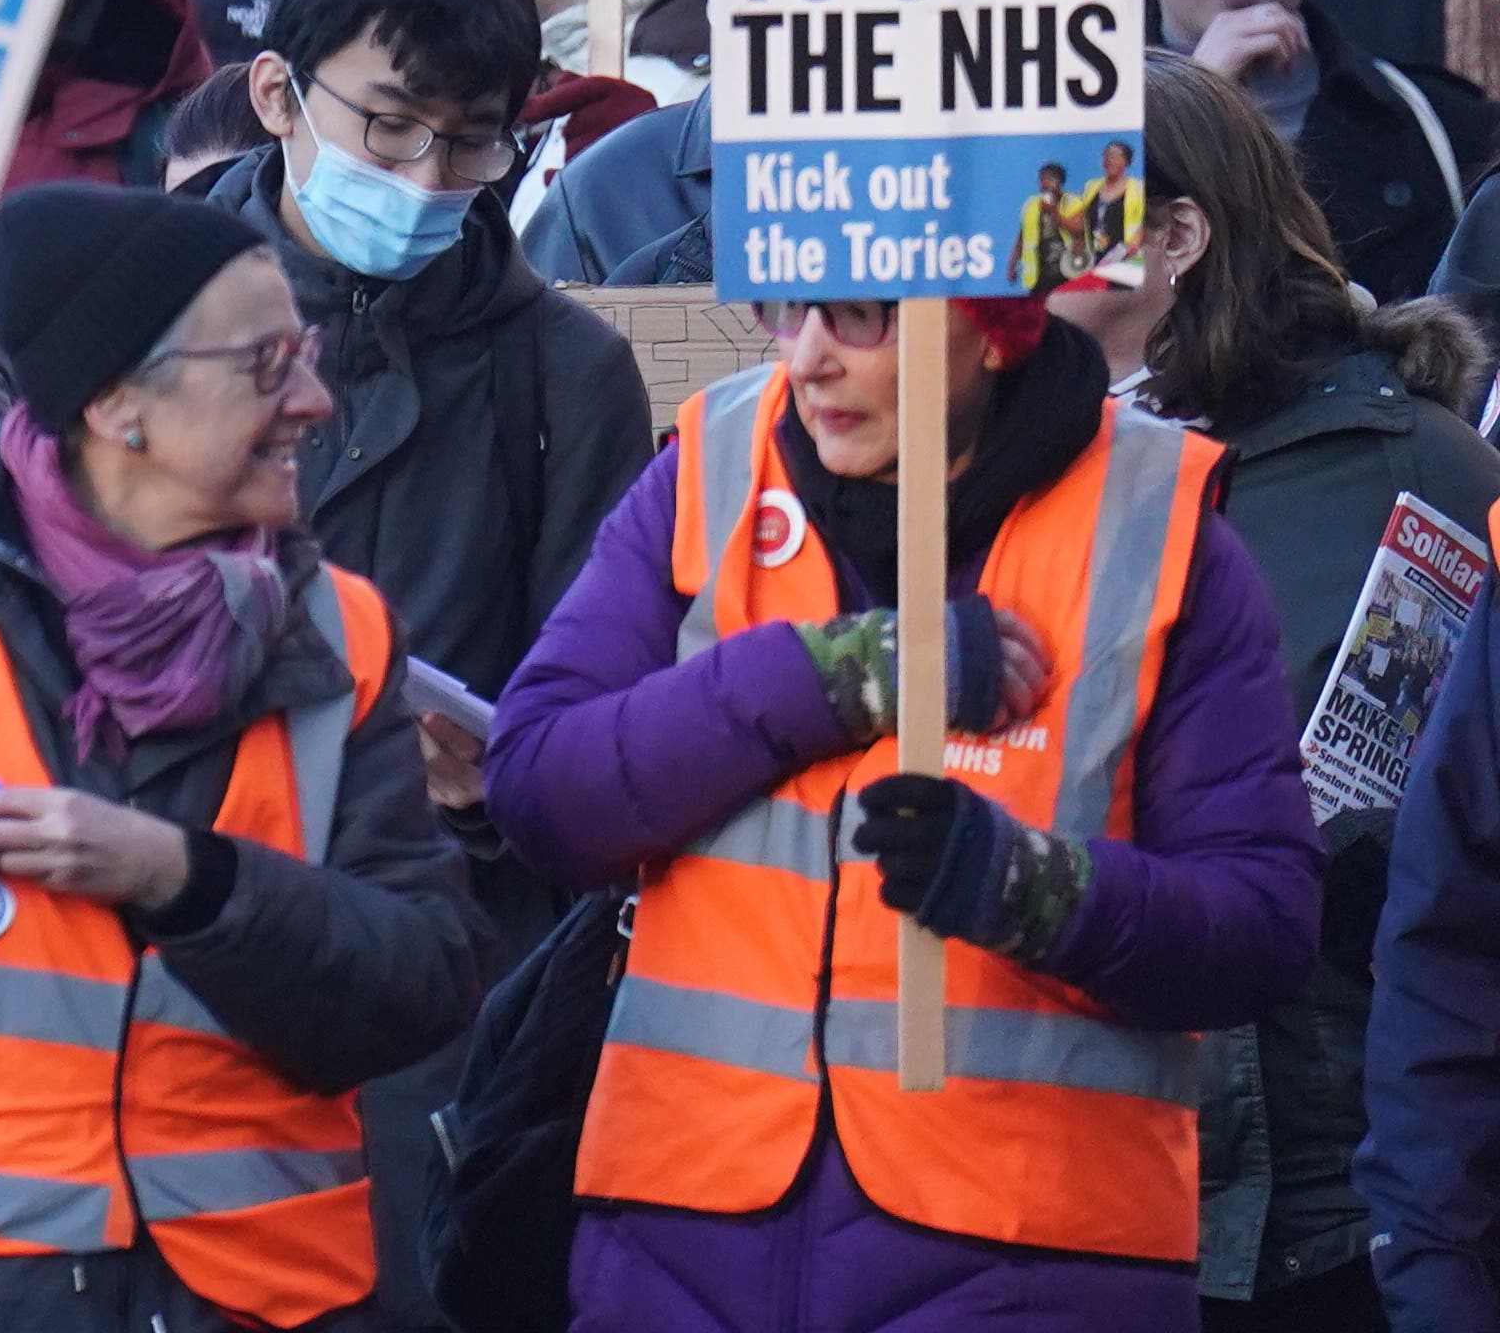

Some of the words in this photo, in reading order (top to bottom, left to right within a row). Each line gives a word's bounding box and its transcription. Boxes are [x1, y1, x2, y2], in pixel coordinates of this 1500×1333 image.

[733, 11, 901, 115] THE
[940, 3, 1118, 112] NHS
[745, 153, 851, 213] Kick
[867, 158, 953, 212] out
[745, 227, 826, 284] the
[842, 221, 995, 284] Tories
[1325, 686, 1399, 741] MAKE
[1311, 764, 1352, 793] Restore
[1353, 788, 1375, 807] NHS
[1318, 748, 1356, 780] Spread,
